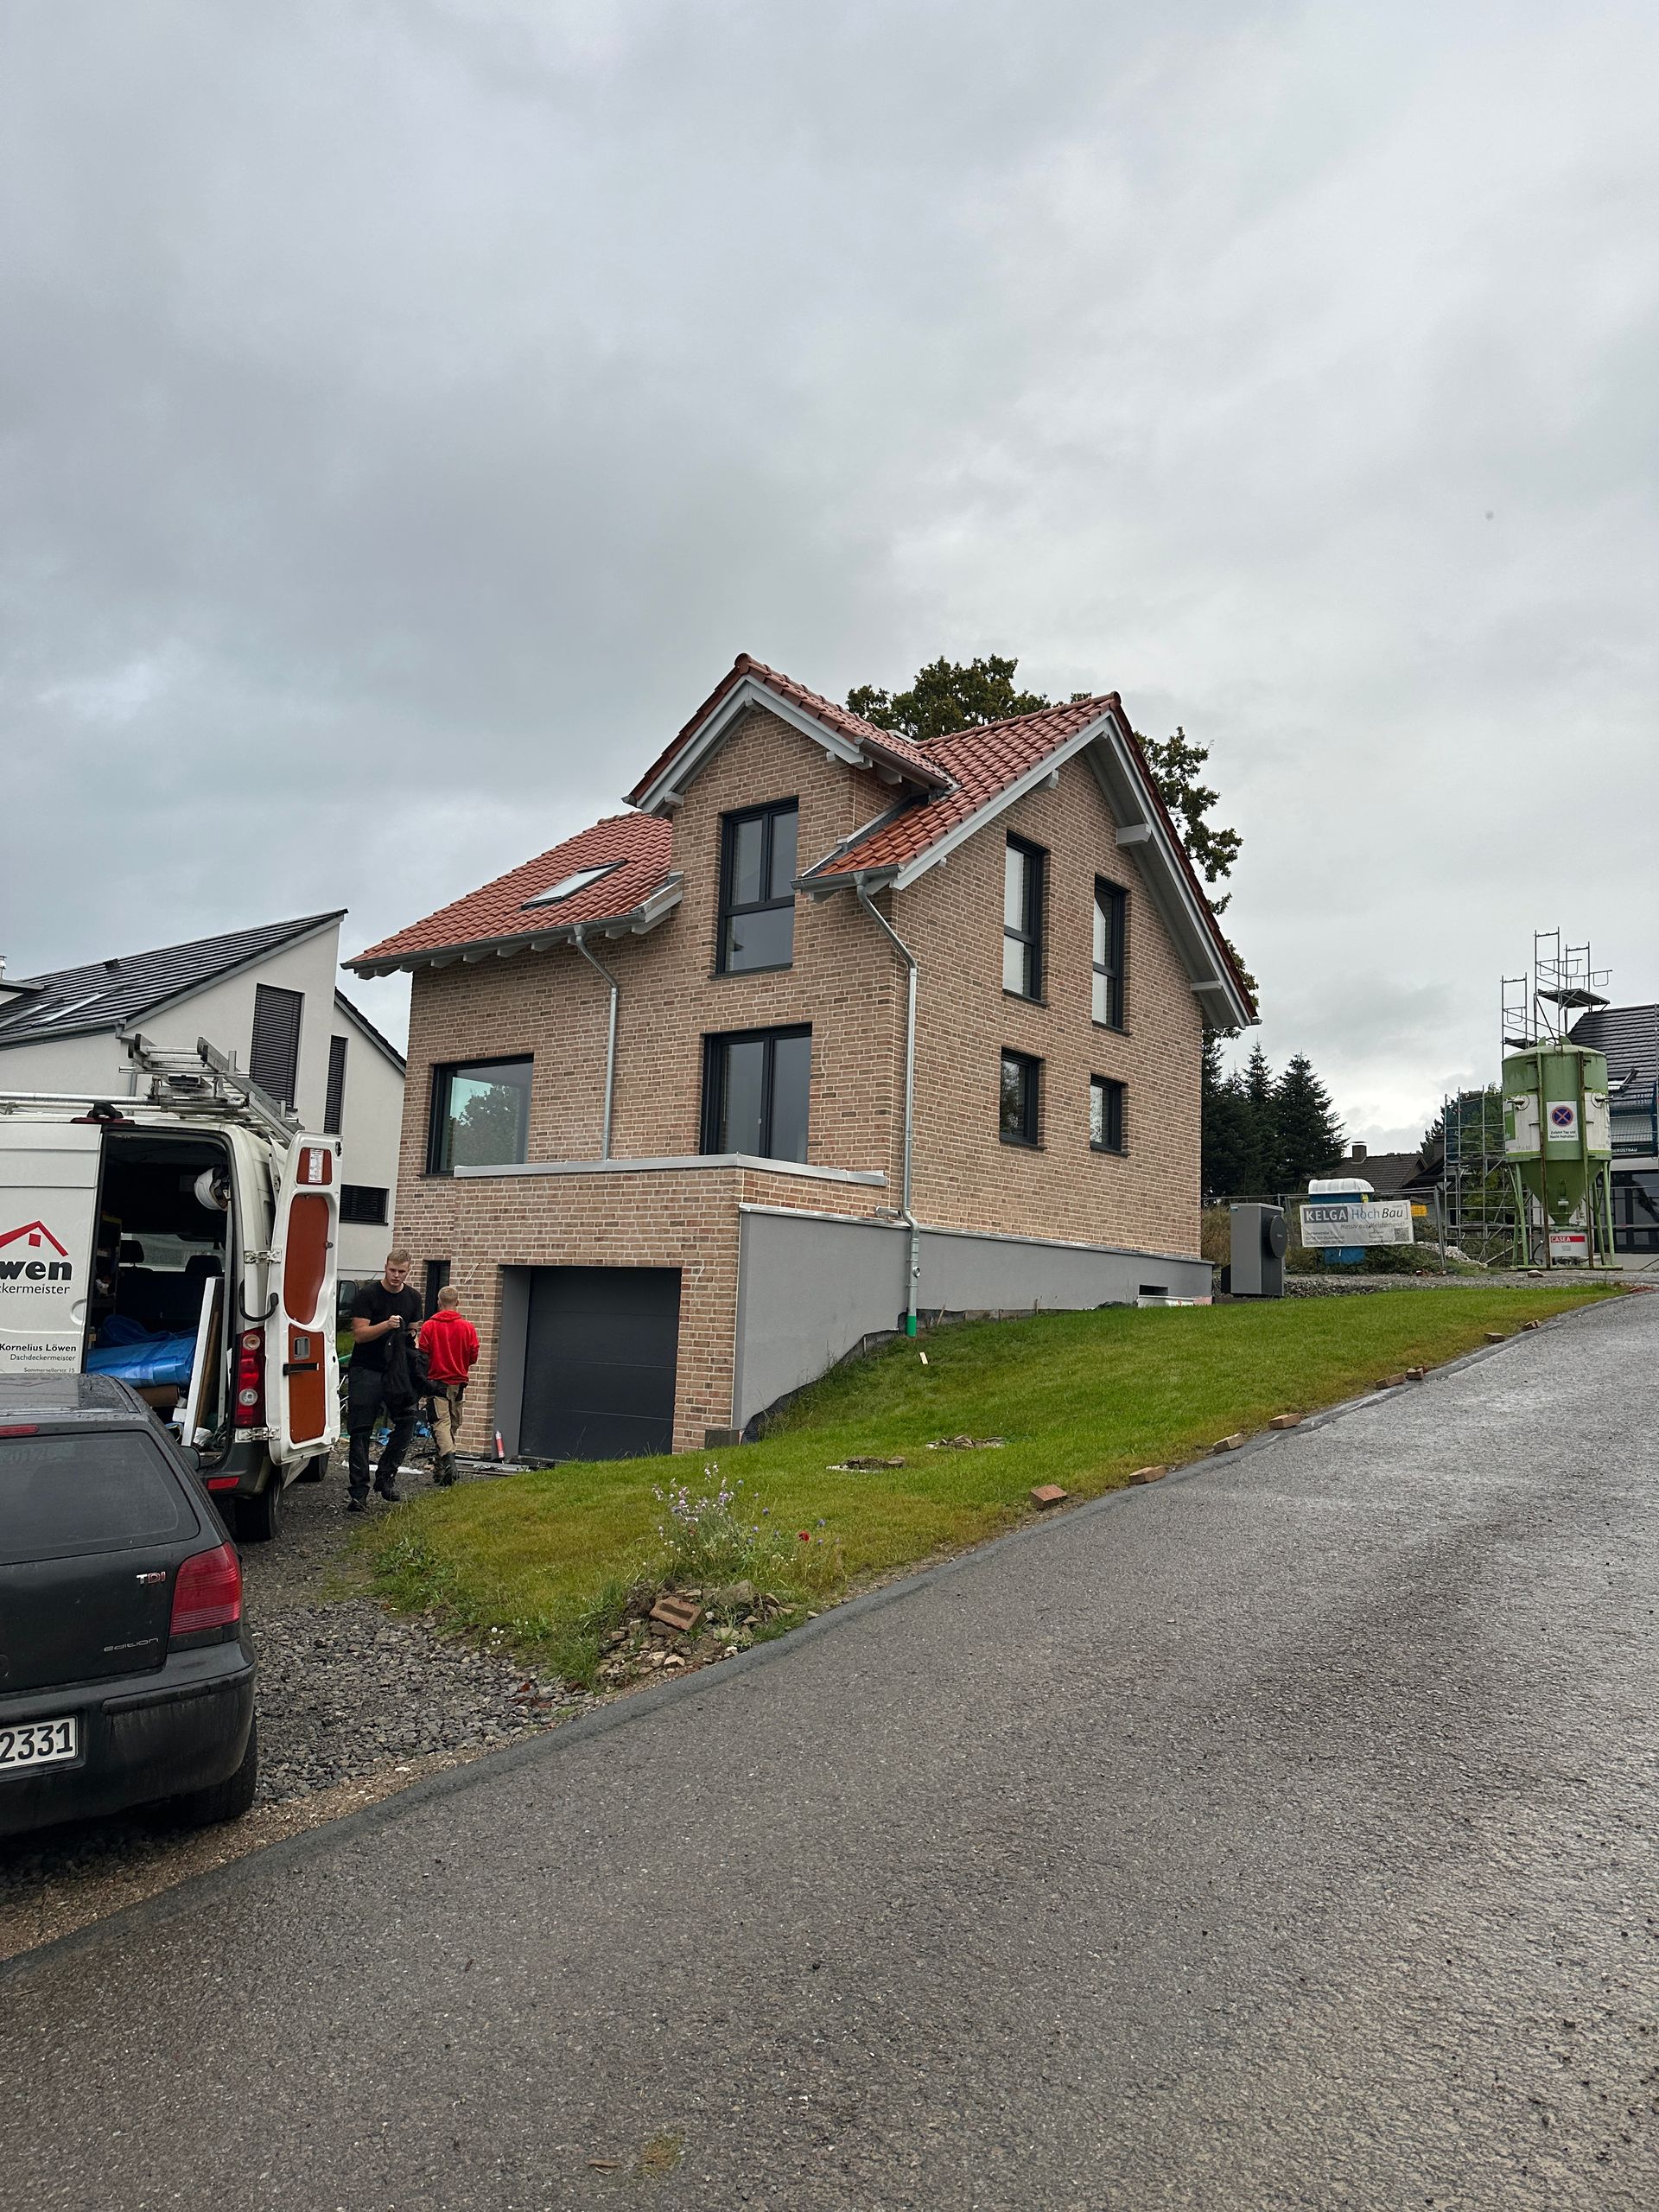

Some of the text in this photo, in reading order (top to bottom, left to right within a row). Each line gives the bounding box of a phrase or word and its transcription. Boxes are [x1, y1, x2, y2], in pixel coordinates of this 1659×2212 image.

[1306, 1209, 1347, 1222] KELGA
[0, 1282, 70, 1294] kermeister
[0, 1343, 77, 1352] Kornelius Löwen
[137, 1571, 166, 1585] TDI
[104, 1637, 159, 1652] edition
[0, 1722, 73, 1763] 2331
